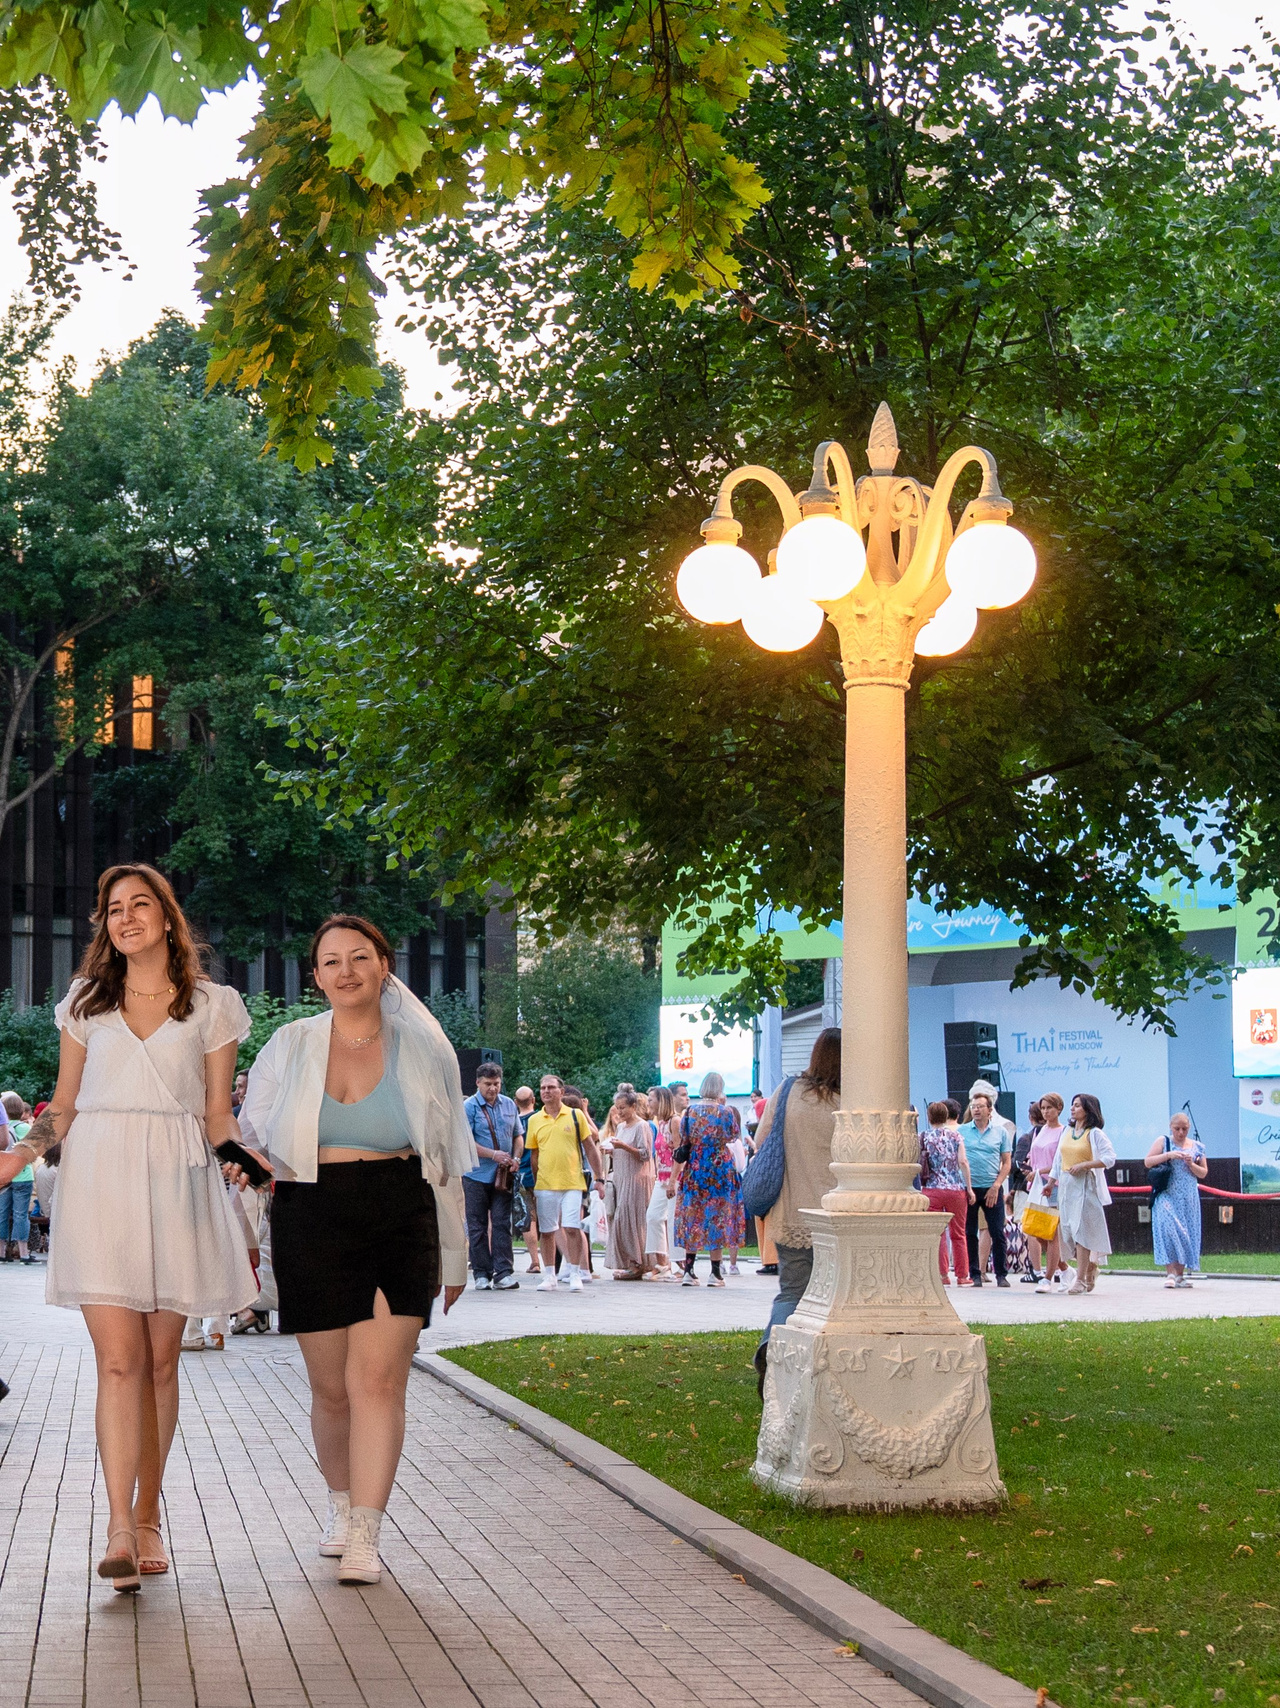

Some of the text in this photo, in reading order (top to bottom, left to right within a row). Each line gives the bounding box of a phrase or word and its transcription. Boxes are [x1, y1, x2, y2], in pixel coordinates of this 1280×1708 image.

[1059, 1030, 1102, 1040] FESTIVAL
[1060, 1042, 1102, 1050] IN MOSCOW
